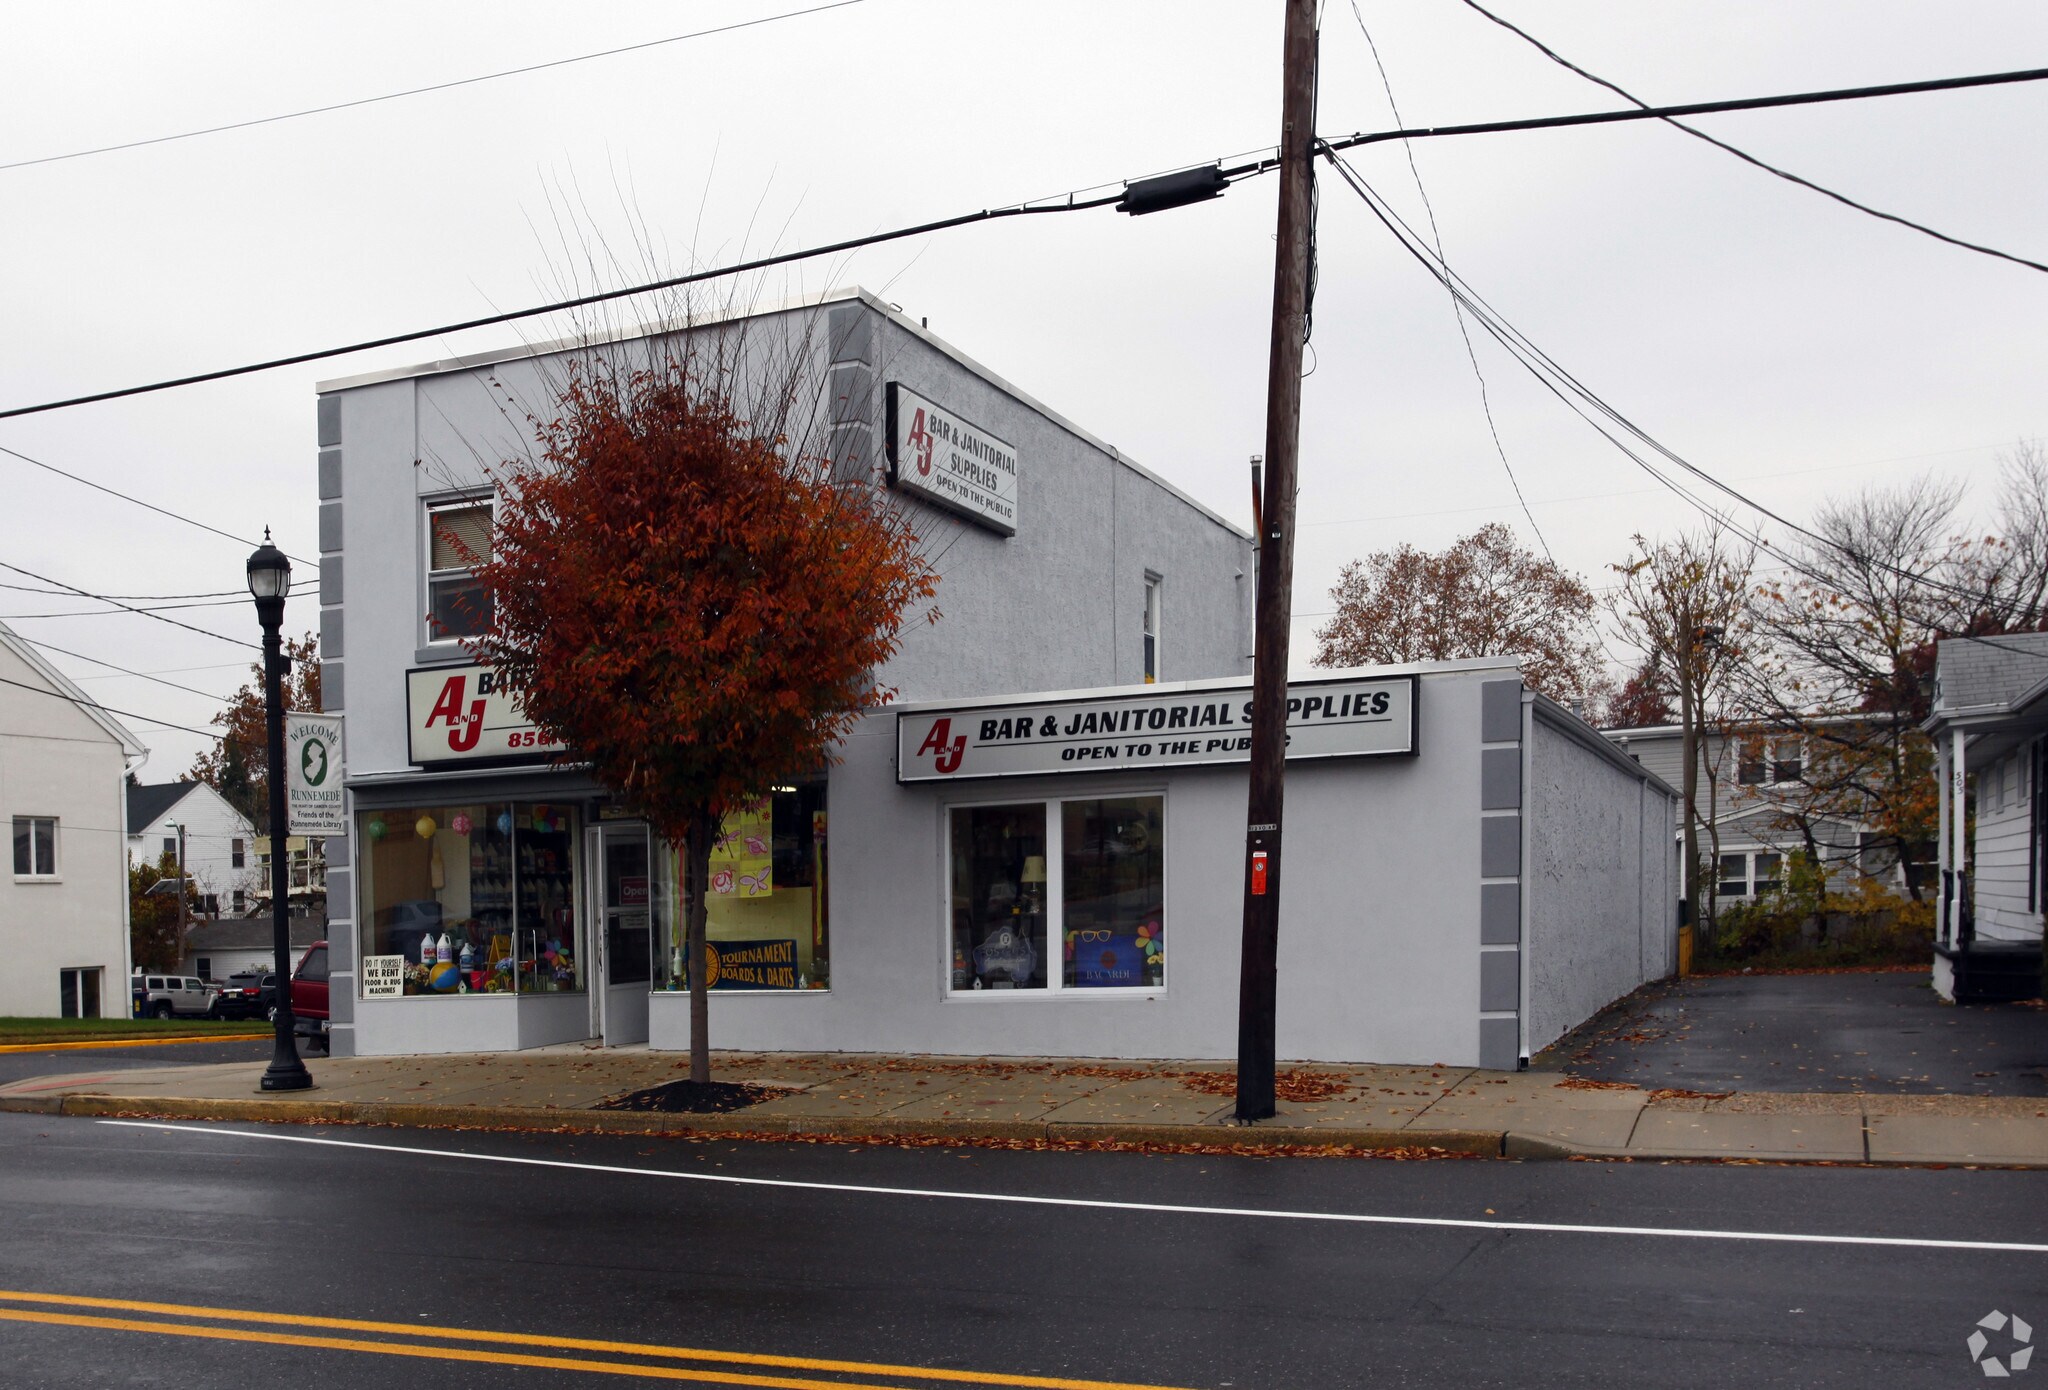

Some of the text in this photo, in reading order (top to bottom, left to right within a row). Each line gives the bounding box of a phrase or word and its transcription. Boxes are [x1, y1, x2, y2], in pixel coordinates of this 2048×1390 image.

[907, 407, 925, 450] A
[917, 435, 934, 477] J
[930, 414, 1016, 476] BAR & JANITORIAL
[951, 453, 998, 491] SUPPLIES
[937, 474, 1012, 518] OPEN TO THE PUBLIC
[425, 675, 487, 752] A AND J
[979, 691, 1390, 741] BAR & JANITORIAL SPPLIES
[290, 724, 339, 746] WELCOME
[917, 718, 951, 756] A
[935, 735, 967, 773] J
[1061, 734, 1291, 761] OPEN TO THE PUB
[1956, 771, 1965, 795] 505
[291, 789, 341, 801] RUNNEMEDE
[291, 820, 342, 829] Runnemede Library
[623, 886, 648, 897] Open
[365, 958, 402, 968] DO IT YOURSELF
[721, 941, 793, 963] TOURNAMENT
[367, 969, 399, 977] WE RENT
[721, 967, 794, 989] BOARDS & DARTS
[1086, 969, 1130, 980] BACARDI
